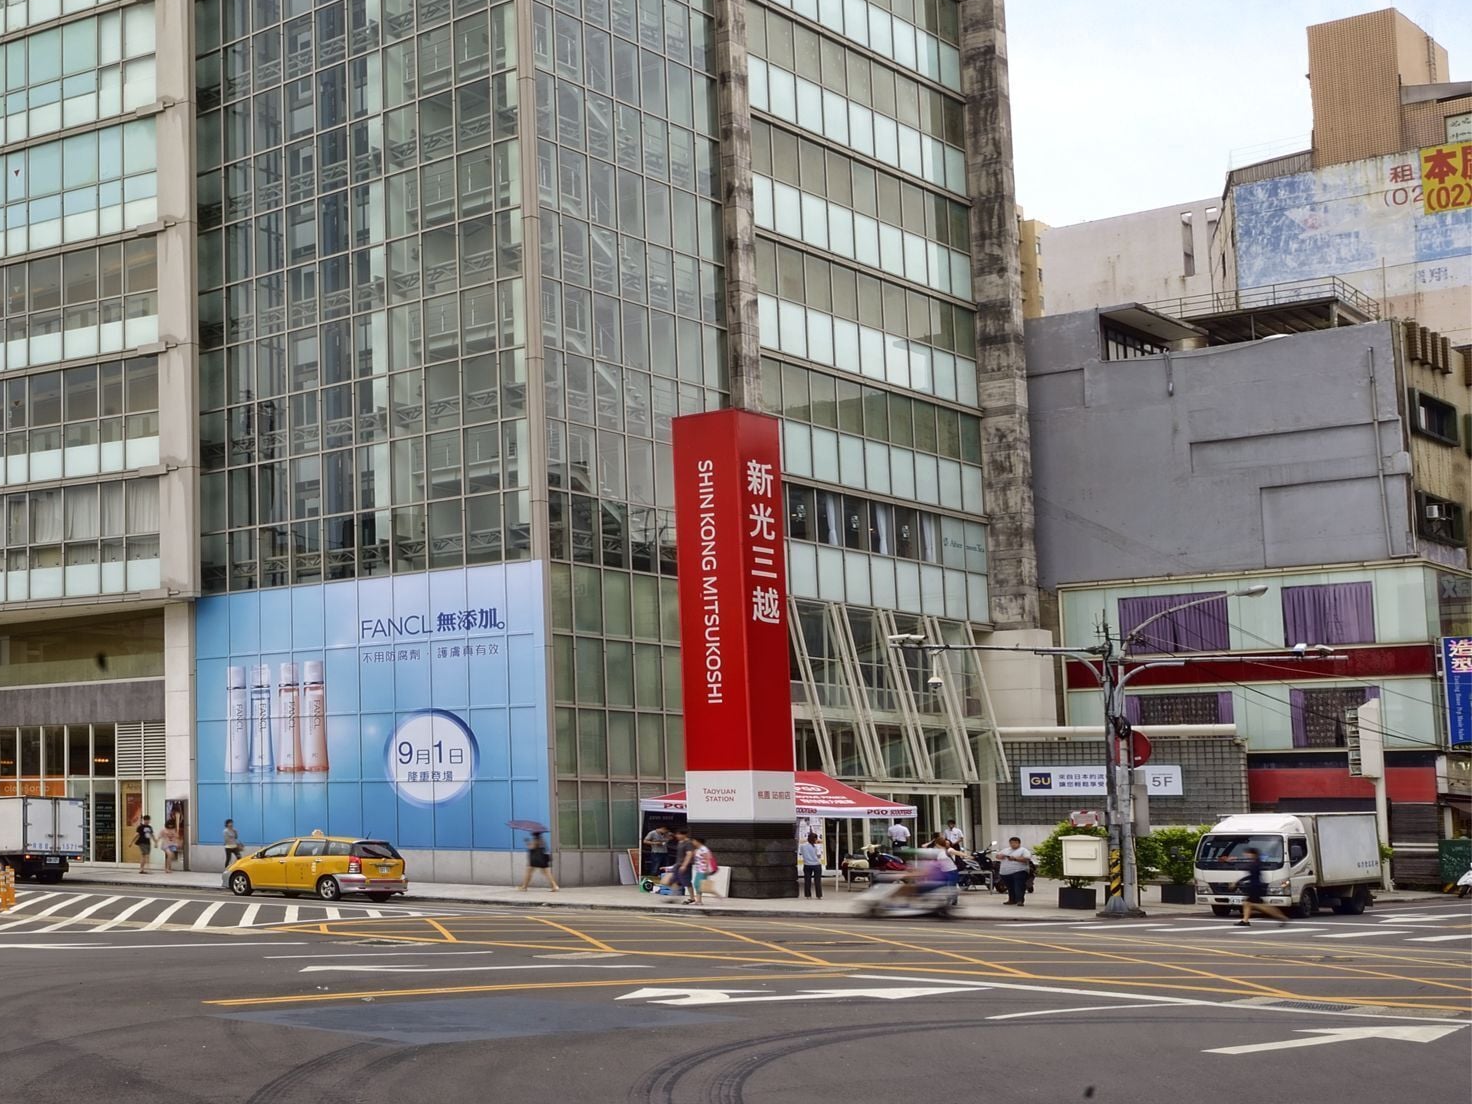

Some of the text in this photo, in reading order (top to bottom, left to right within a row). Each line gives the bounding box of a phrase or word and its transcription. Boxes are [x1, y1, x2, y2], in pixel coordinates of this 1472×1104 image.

[1390, 164, 1415, 183] 租
[746, 459, 780, 624] 新光三越
[698, 459, 723, 704] SHIN KONG MITSUKOSHI
[361, 615, 433, 639] FANCL
[398, 740, 463, 764] 9月1日
[1030, 776, 1050, 785] GU
[1151, 776, 1173, 787] 5F
